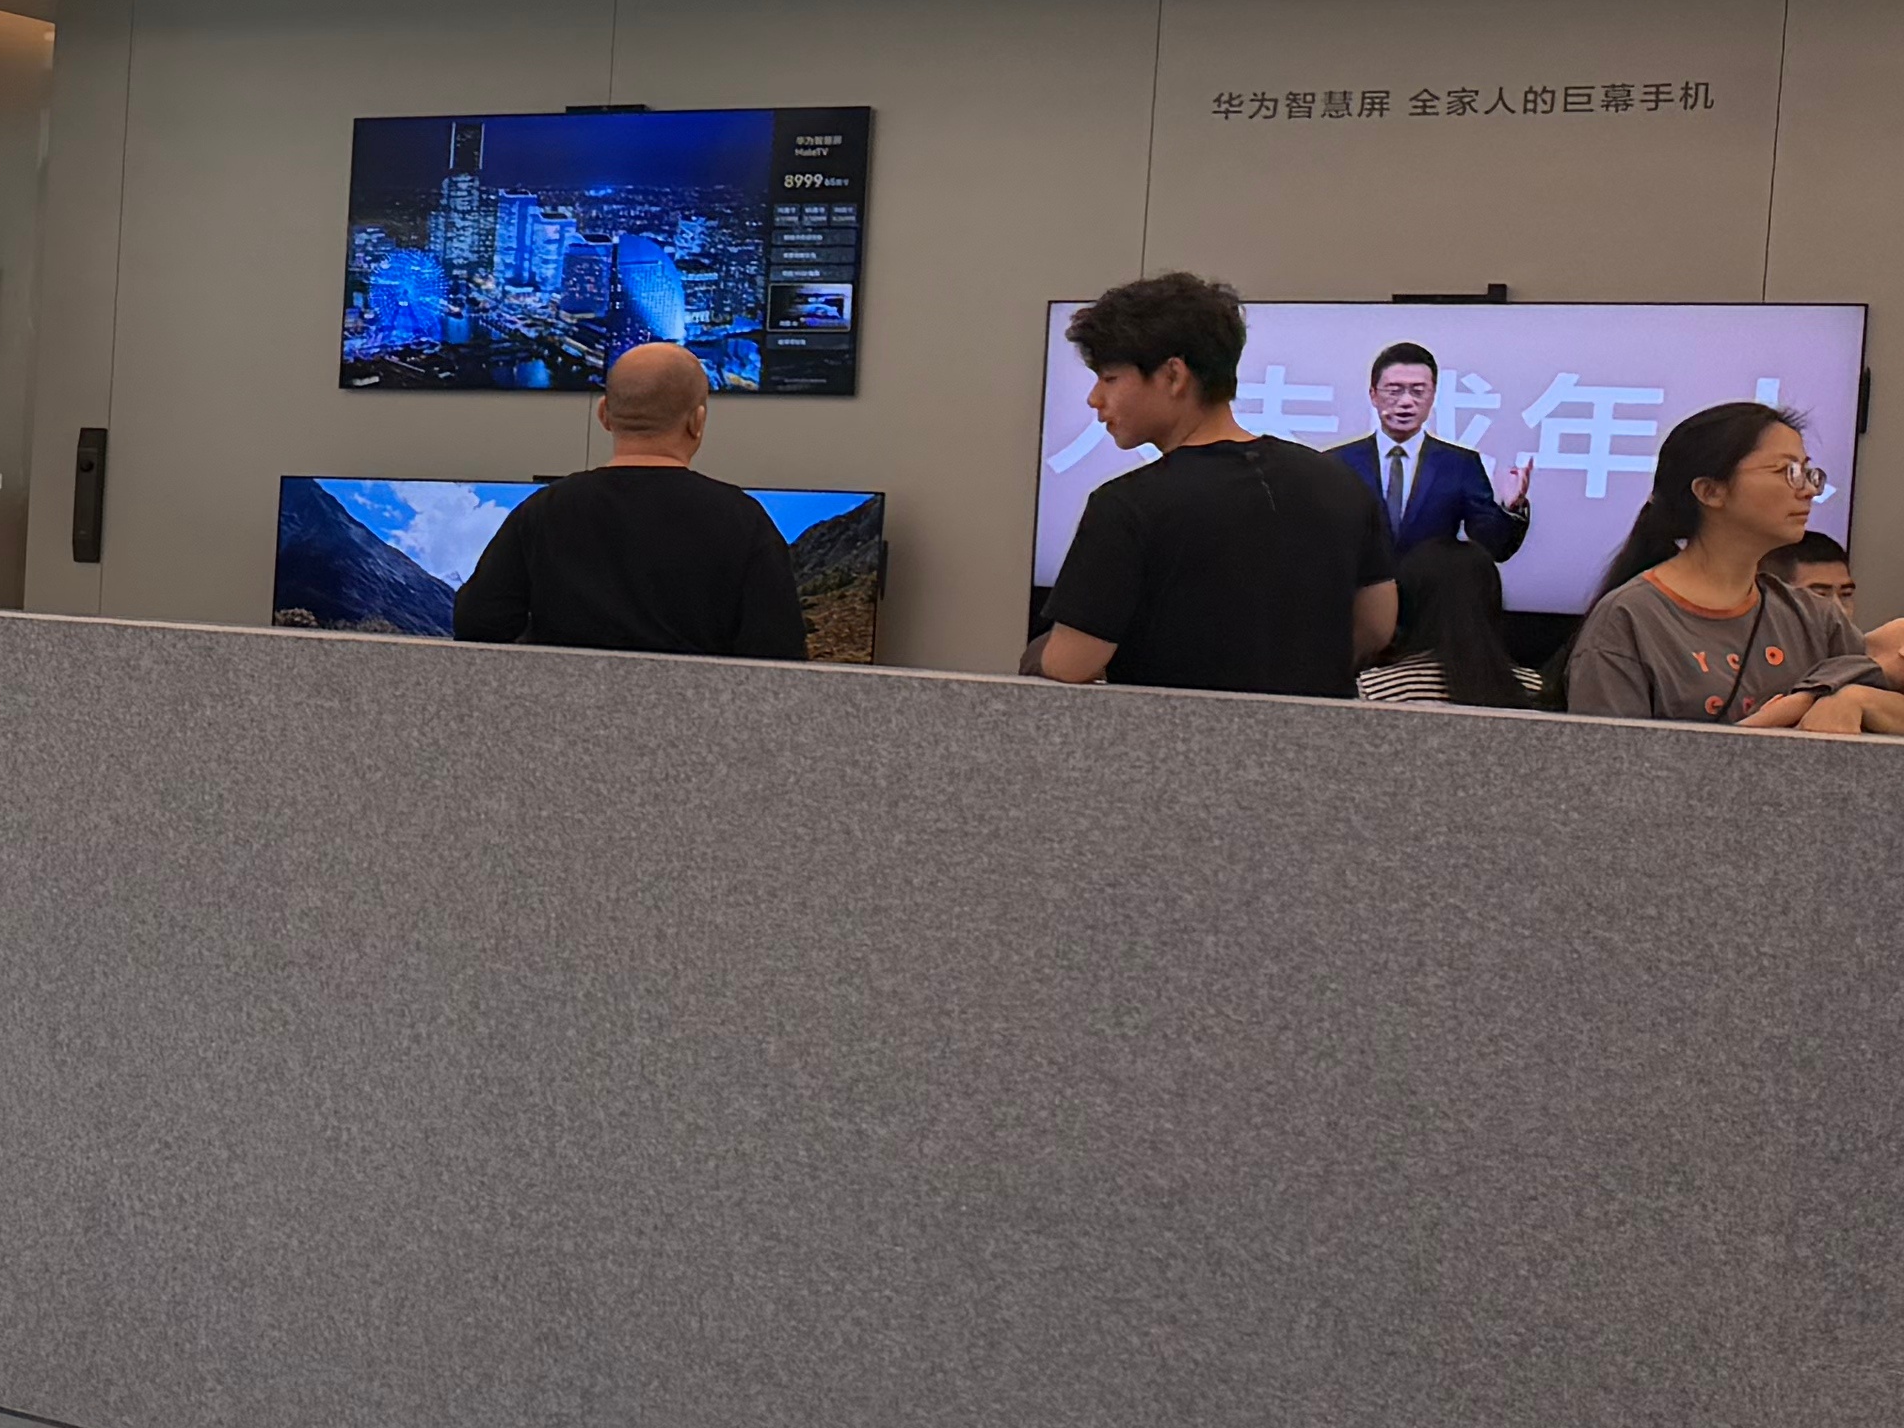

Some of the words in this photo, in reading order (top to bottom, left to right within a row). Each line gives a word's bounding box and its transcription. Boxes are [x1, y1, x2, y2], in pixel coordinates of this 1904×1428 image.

[1212, 89, 1391, 121] 华为智慧屏
[1408, 80, 1715, 117] 全家人的巨幕手机
[783, 173, 824, 189] 8999
